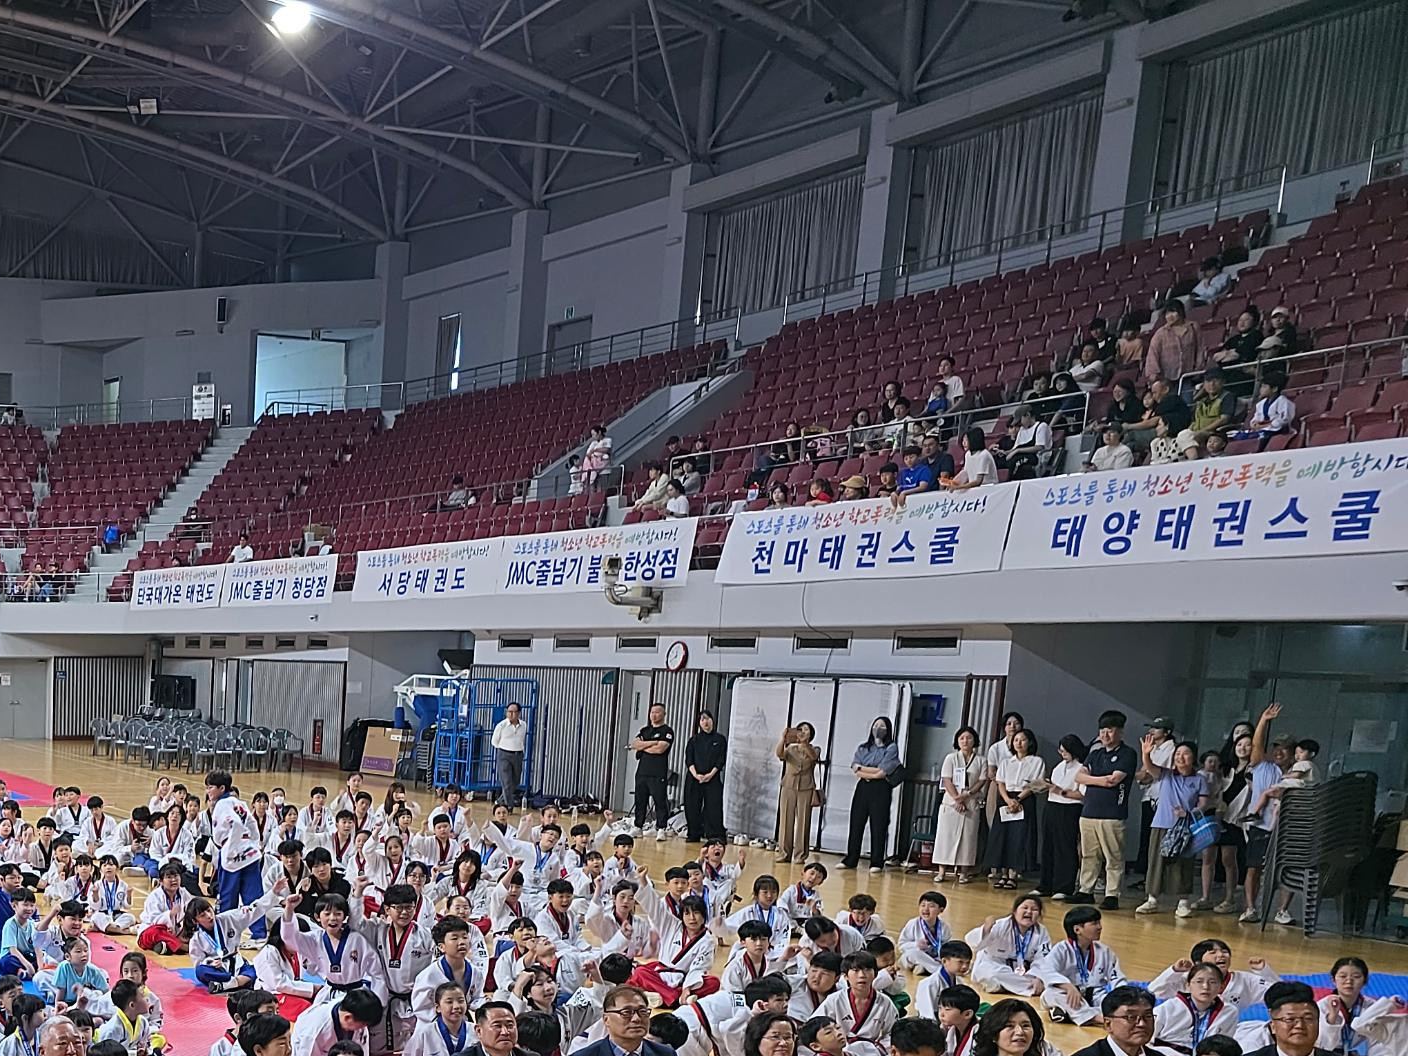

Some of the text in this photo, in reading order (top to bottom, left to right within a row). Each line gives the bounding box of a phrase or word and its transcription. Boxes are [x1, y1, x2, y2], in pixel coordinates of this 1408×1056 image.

[1043, 484, 1099, 507] 스포츠를
[1102, 479, 1137, 503] 통해
[1141, 474, 1194, 499] 청소년
[1199, 459, 1292, 491] 학교폭력을
[745, 516, 782, 535] 스포츠를
[786, 515, 808, 533] 통해
[811, 511, 846, 531] 청소년
[909, 495, 987, 520] 예방합시다!
[1051, 489, 1381, 557] 태양태권스쿨
[624, 527, 678, 545] 예방합시다!
[751, 526, 960, 574] 천마태권스쿨
[378, 568, 465, 596] 서당태권도
[504, 547, 679, 589] JMC줄넘기 불한성점
[186, 583, 216, 603] 태권도
[228, 577, 287, 603] JMC줄넘기
